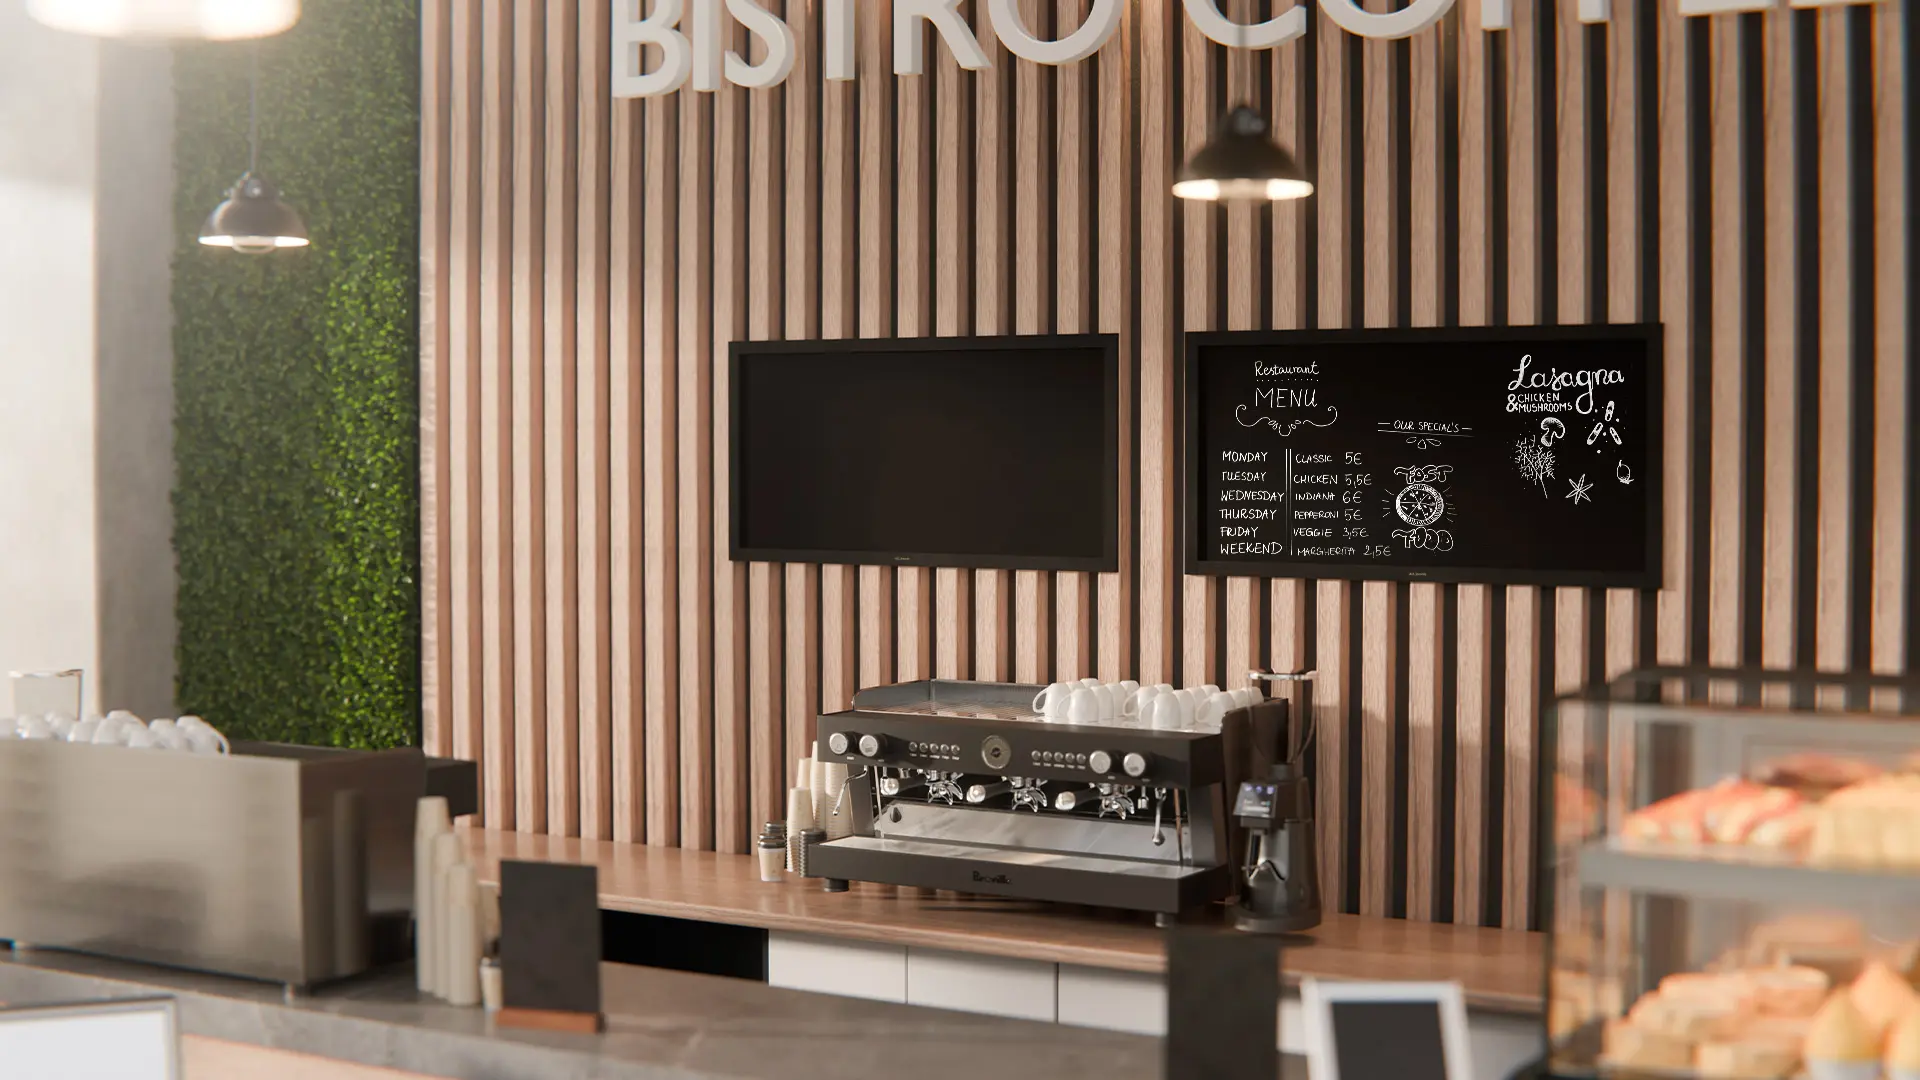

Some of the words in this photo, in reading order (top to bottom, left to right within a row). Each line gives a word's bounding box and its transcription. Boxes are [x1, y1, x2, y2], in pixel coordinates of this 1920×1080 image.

[1254, 360, 1320, 377] Restaurant
[1507, 354, 1625, 415] Lasagna
[1255, 387, 1318, 409] MENU
[1518, 392, 1560, 403] CHICKEN
[1518, 402, 1573, 413] MUSHROOMS
[1393, 419, 1415, 430] OUR
[1418, 421, 1460, 433] SPECIAL'S
[1222, 450, 1269, 463] MONDAY
[1295, 453, 1333, 464] CLASSIC
[1344, 451, 1363, 466] 5€
[1221, 470, 1267, 482] TUESDAY
[1293, 474, 1338, 485] CHICKEN
[1344, 473, 1372, 489] 5,5€
[1220, 489, 1285, 503] WEDNESDAY
[1342, 490, 1363, 504] 6€
[1218, 508, 1278, 521] THURSDAY
[1294, 510, 1339, 520] PEPPERONI
[1344, 508, 1363, 522] 5€
[1219, 526, 1259, 539] FRIDAY
[1293, 527, 1333, 538] VEGGIE
[1391, 526, 1454, 552] FOOD
[1220, 541, 1283, 556] WEEKEND
[1297, 546, 1356, 557] MARGHERITA
[1362, 544, 1392, 559] 2,5€
